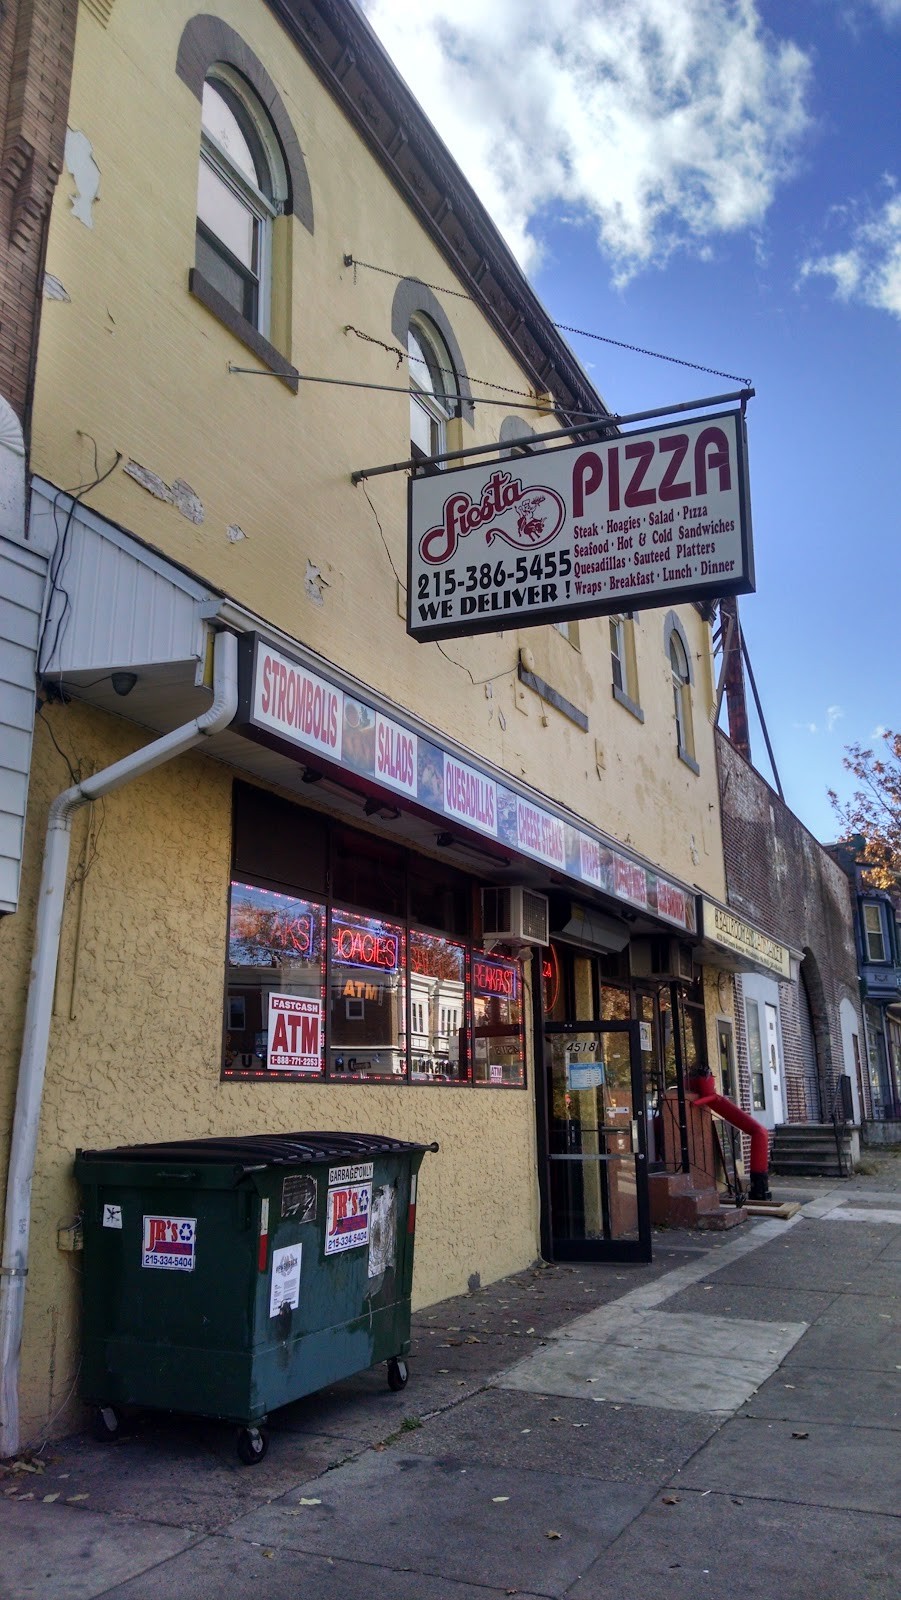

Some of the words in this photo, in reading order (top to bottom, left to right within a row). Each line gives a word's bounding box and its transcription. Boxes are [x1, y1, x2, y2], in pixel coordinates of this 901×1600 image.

[572, 426, 732, 519] PIZZA
[573, 523, 599, 540] Steak
[606, 515, 641, 534] Hoagies
[648, 508, 674, 526] Salad
[682, 505, 708, 520] Pizza
[573, 539, 609, 559] Seafood
[617, 535, 633, 551] Hot
[638, 533, 647, 547] &
[652, 528, 673, 545] Cold
[678, 519, 735, 540] Sandwiches
[417, 549, 572, 600] 215-386-5455
[573, 555, 626, 579] Quesadillas
[633, 547, 670, 566] Sauteed
[676, 541, 716, 559] Platters
[574, 580, 602, 596] Wraps
[609, 570, 655, 591] Breakfast
[663, 563, 692, 582] Lunch
[700, 559, 735, 576] Dinner
[417, 598, 453, 622] WE
[460, 583, 558, 616] DELIVER
[261, 655, 338, 748] STROMBOLIS
[377, 721, 414, 787] SALADS
[446, 760, 495, 828] QUESADILLAS
[273, 998, 319, 1014] FASTCASH
[342, 979, 379, 1001] ATM
[271, 1013, 319, 1055] ATM
[566, 1042, 596, 1052] 4518
[270, 1055, 319, 1067] 1-888-771-2253
[329, 1166, 358, 1183] GARBAGE
[328, 1190, 359, 1237] JR's
[145, 1219, 179, 1252] JR's
[327, 1231, 368, 1250] 215-334-5404
[144, 1254, 193, 1268] 215-334-5404
